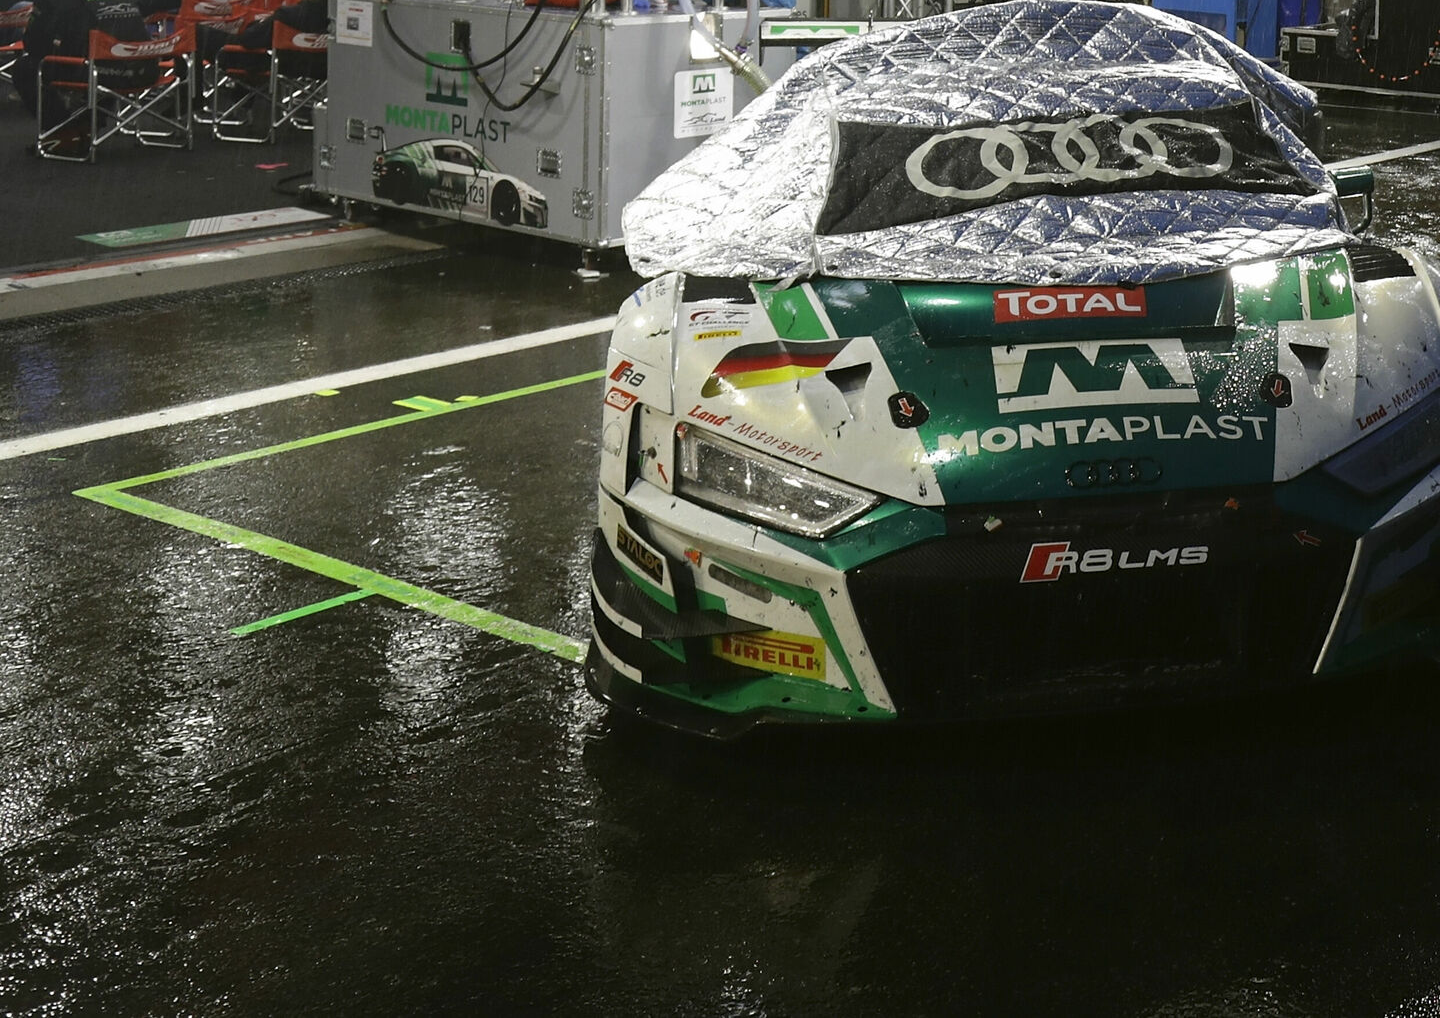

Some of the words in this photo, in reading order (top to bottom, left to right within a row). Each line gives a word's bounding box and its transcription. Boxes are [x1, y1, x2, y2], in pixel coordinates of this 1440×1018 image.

[681, 96, 727, 108] MONTAPLAST
[385, 103, 511, 144] MONTAPLAST
[468, 185, 485, 204] 129
[998, 292, 1142, 316] TOTAL
[937, 415, 1268, 457] MONTAPLAST
[721, 633, 814, 671] PIRELLI
